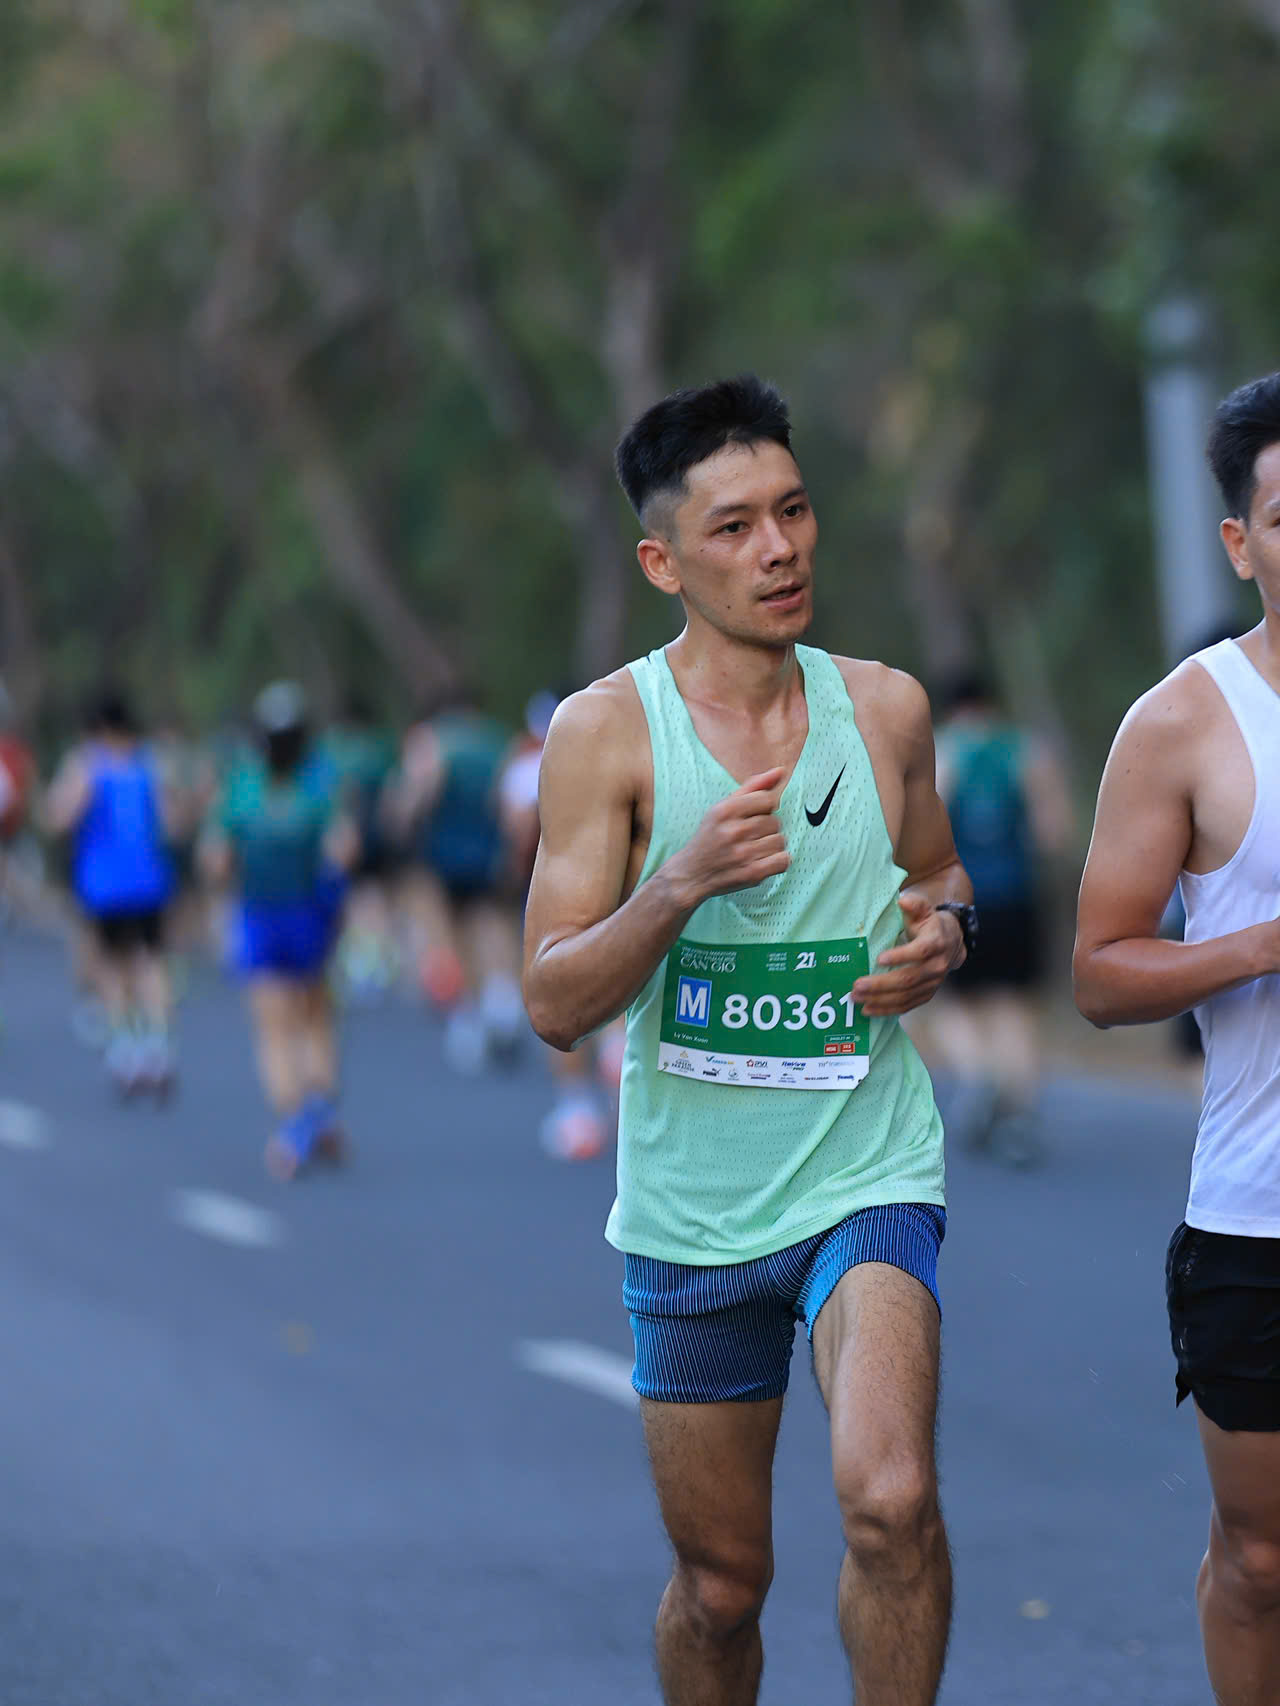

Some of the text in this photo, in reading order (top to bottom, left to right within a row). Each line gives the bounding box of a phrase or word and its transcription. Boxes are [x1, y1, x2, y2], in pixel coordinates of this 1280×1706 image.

[680, 956, 737, 974] CAN GIO
[827, 955, 850, 964] 80361
[680, 983, 708, 1020] M
[721, 991, 856, 1031] 80361
